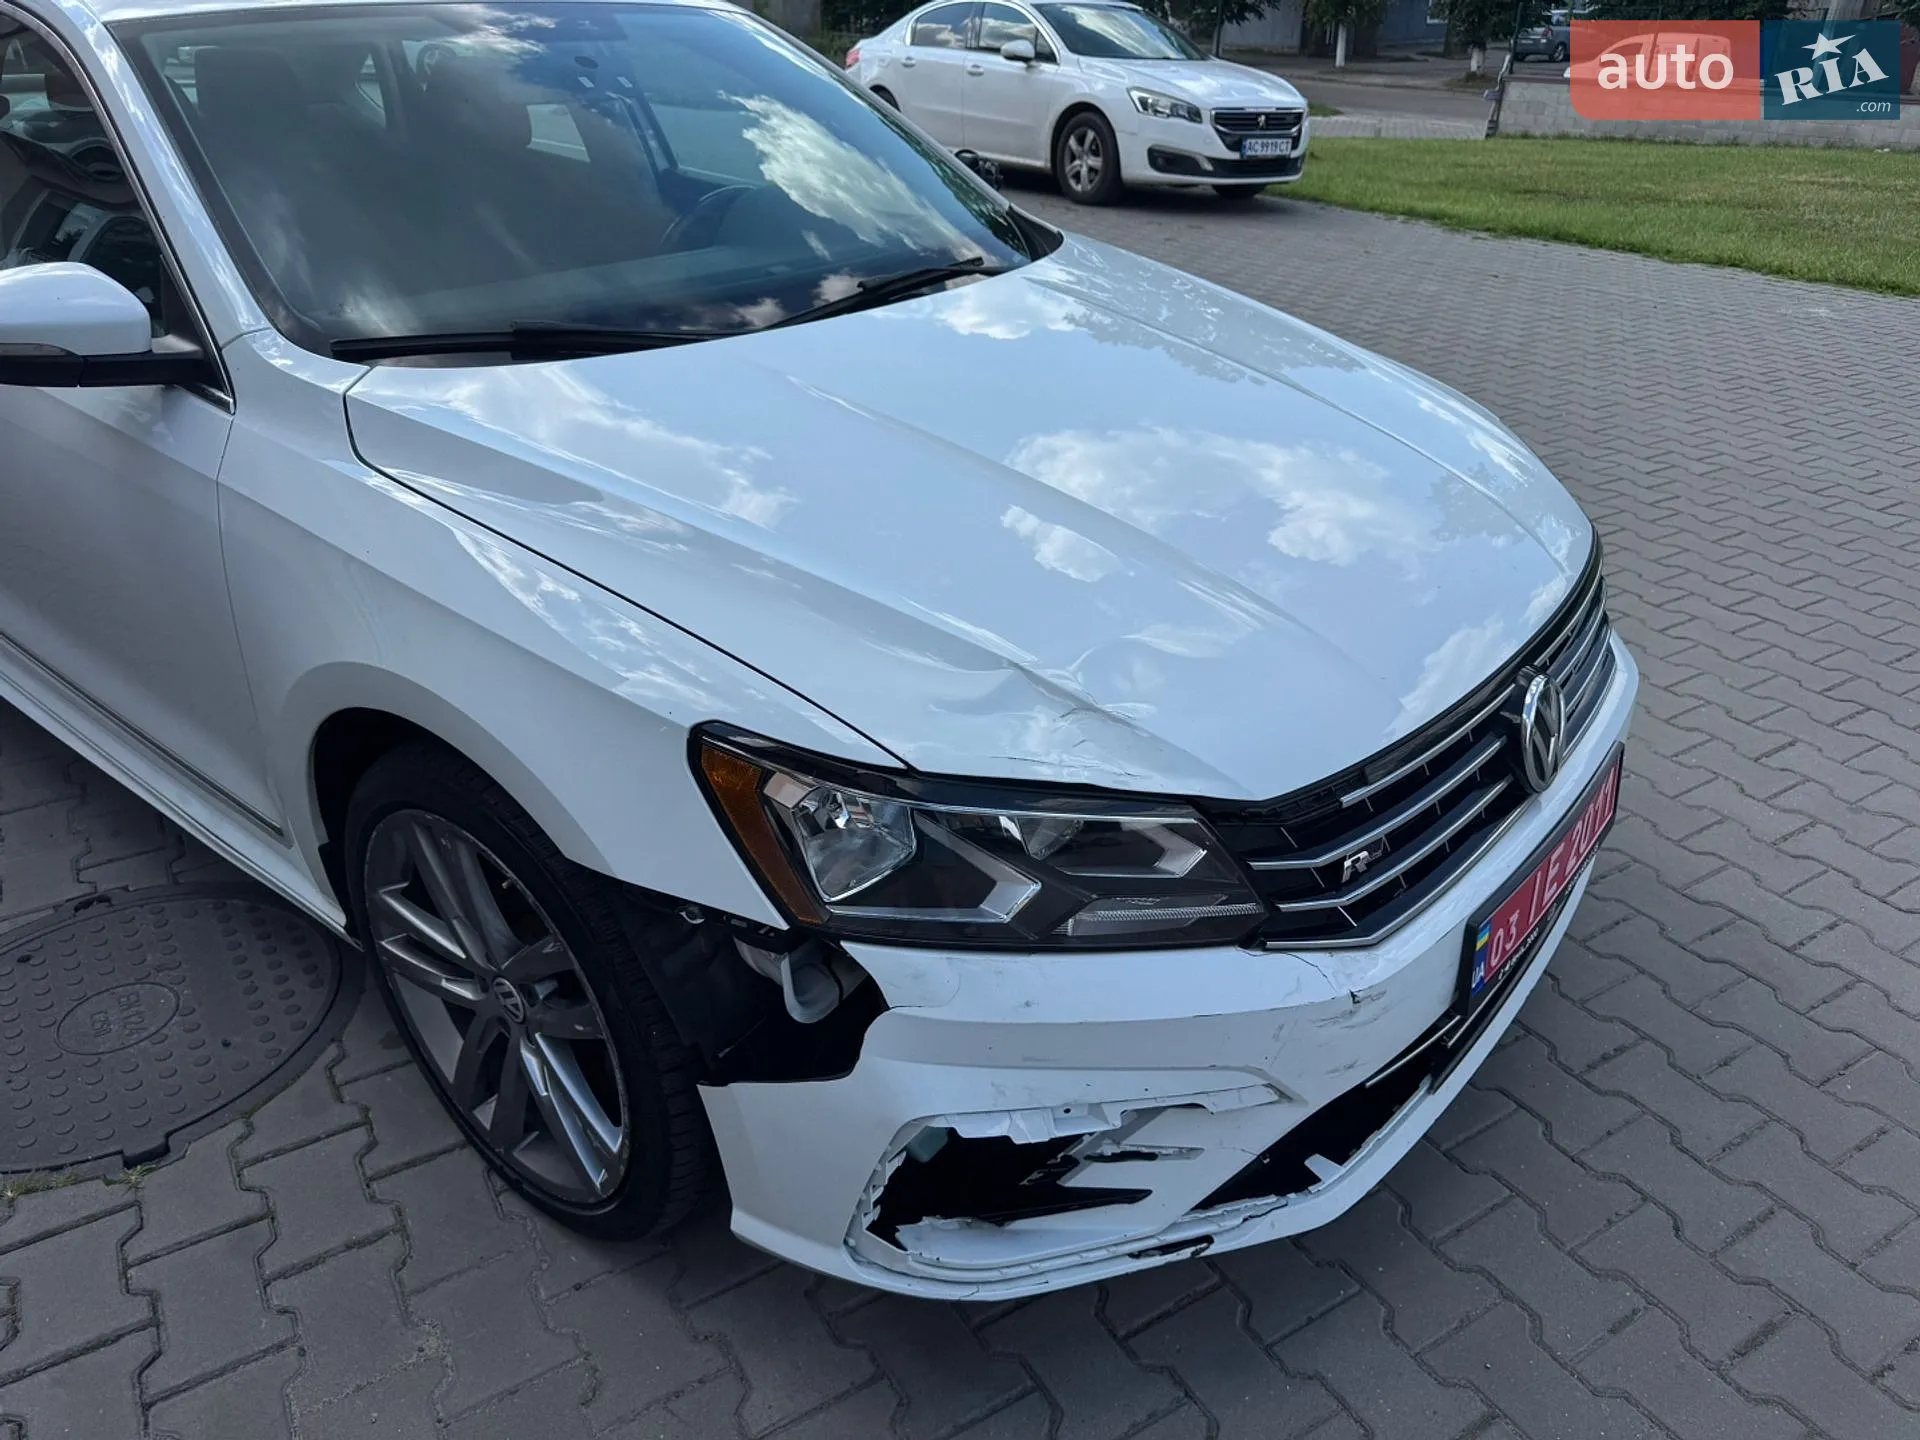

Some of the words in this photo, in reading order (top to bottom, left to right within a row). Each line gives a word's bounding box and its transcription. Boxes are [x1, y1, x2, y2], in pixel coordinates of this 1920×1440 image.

[1248, 140, 1259, 153] AC
[1490, 909, 1520, 968] 03
[1471, 960, 1484, 989] UA
